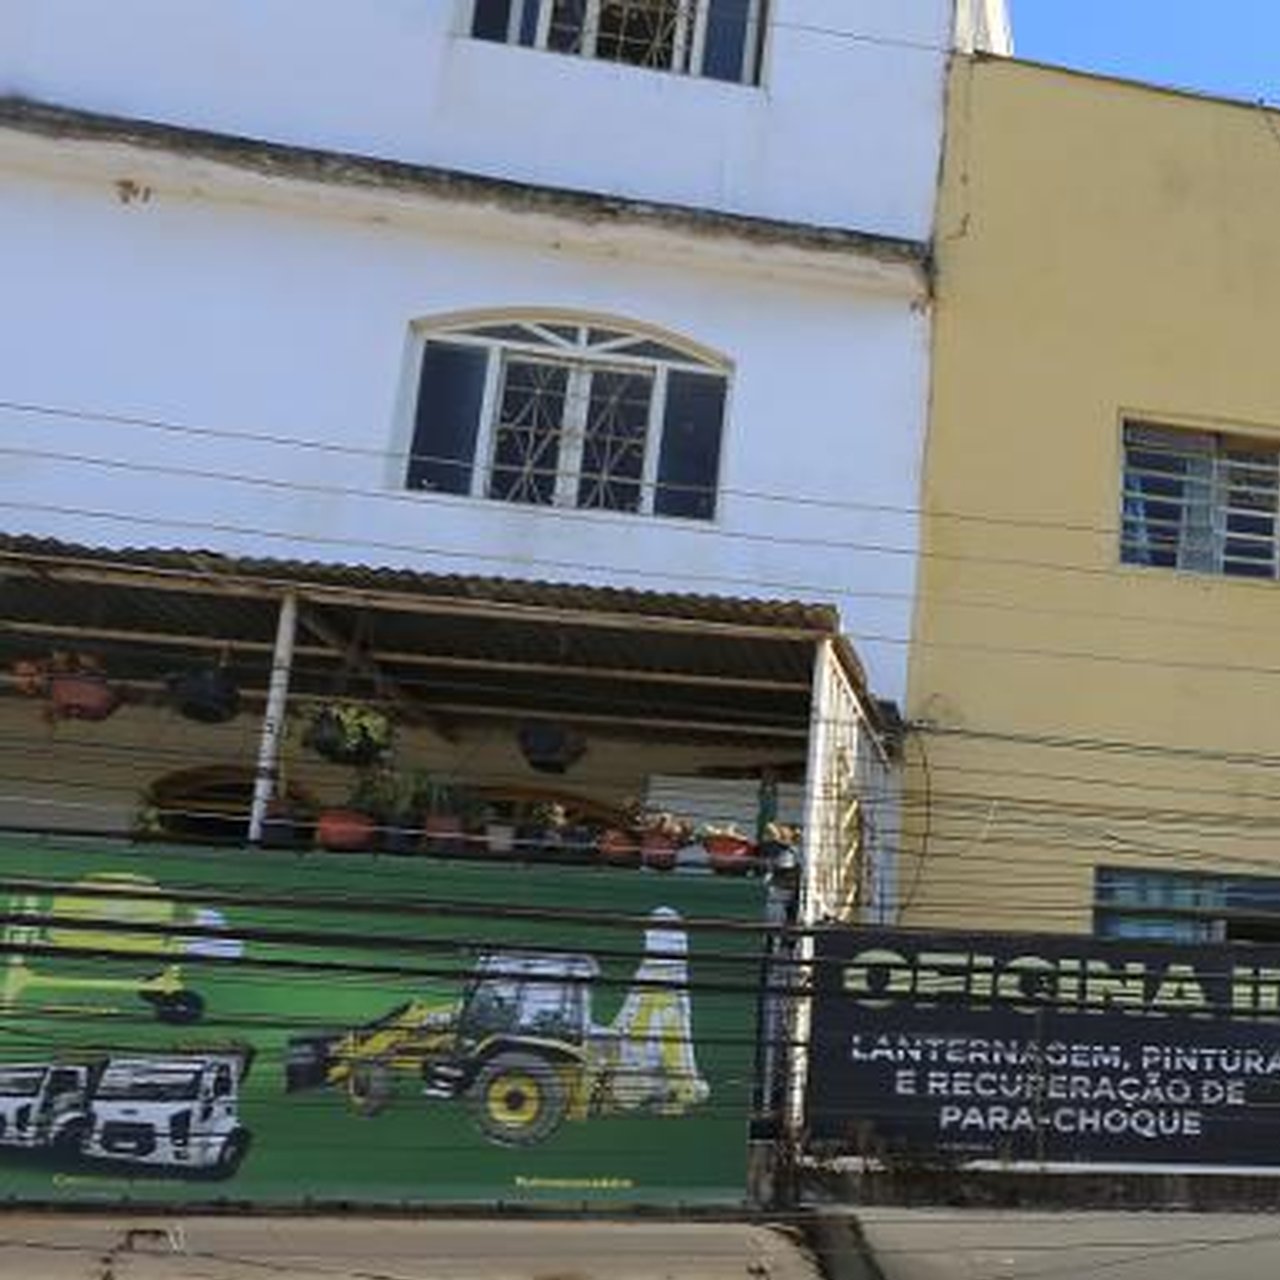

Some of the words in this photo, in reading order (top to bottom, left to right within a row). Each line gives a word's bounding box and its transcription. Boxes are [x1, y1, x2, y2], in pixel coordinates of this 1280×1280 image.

[843, 949, 1213, 1018] OFICINA
[851, 1035, 1132, 1070] LANTERNAGEM,
[896, 1071, 917, 1096] E
[928, 1071, 1191, 1107] RECUPERAÇÃO
[1201, 1080, 1247, 1105] DE
[940, 1107, 1201, 1137] PARA-CHOQUE
